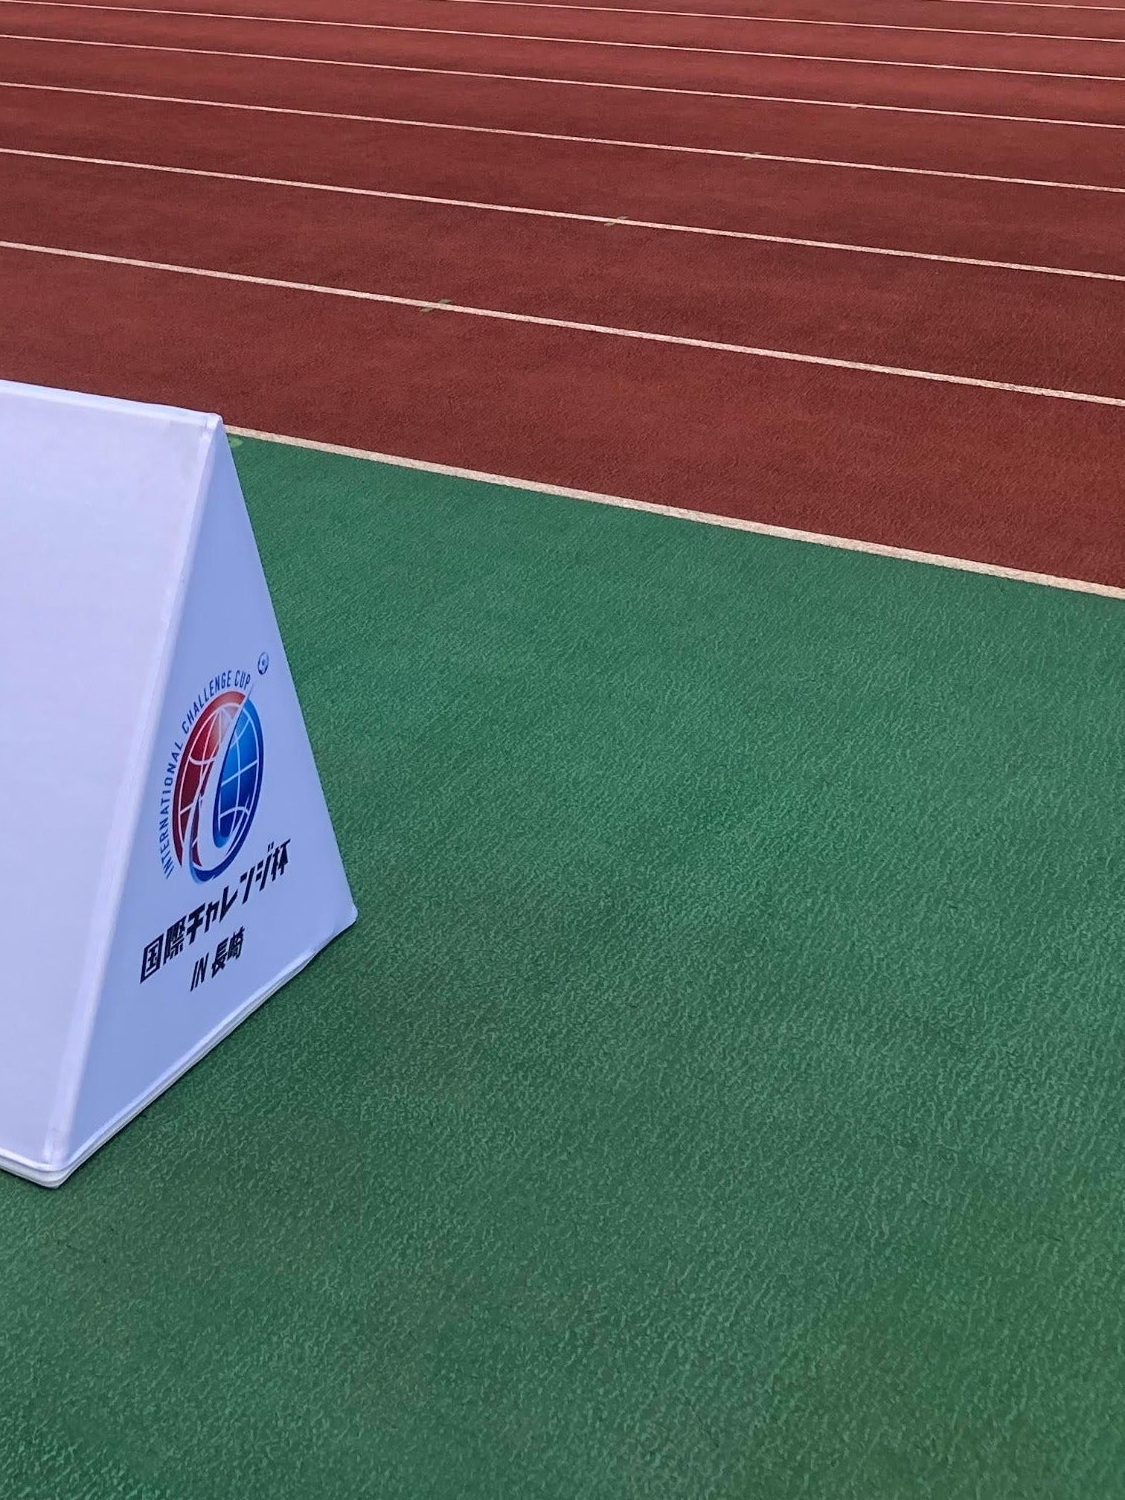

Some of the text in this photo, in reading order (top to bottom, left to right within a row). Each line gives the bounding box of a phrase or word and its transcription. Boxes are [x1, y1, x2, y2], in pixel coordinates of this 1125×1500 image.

[159, 669, 251, 880] INTERNATIONAL CHALLENGE CUP
[140, 838, 291, 985] 国際チャレンジ杯
[190, 952, 209, 992] IN
